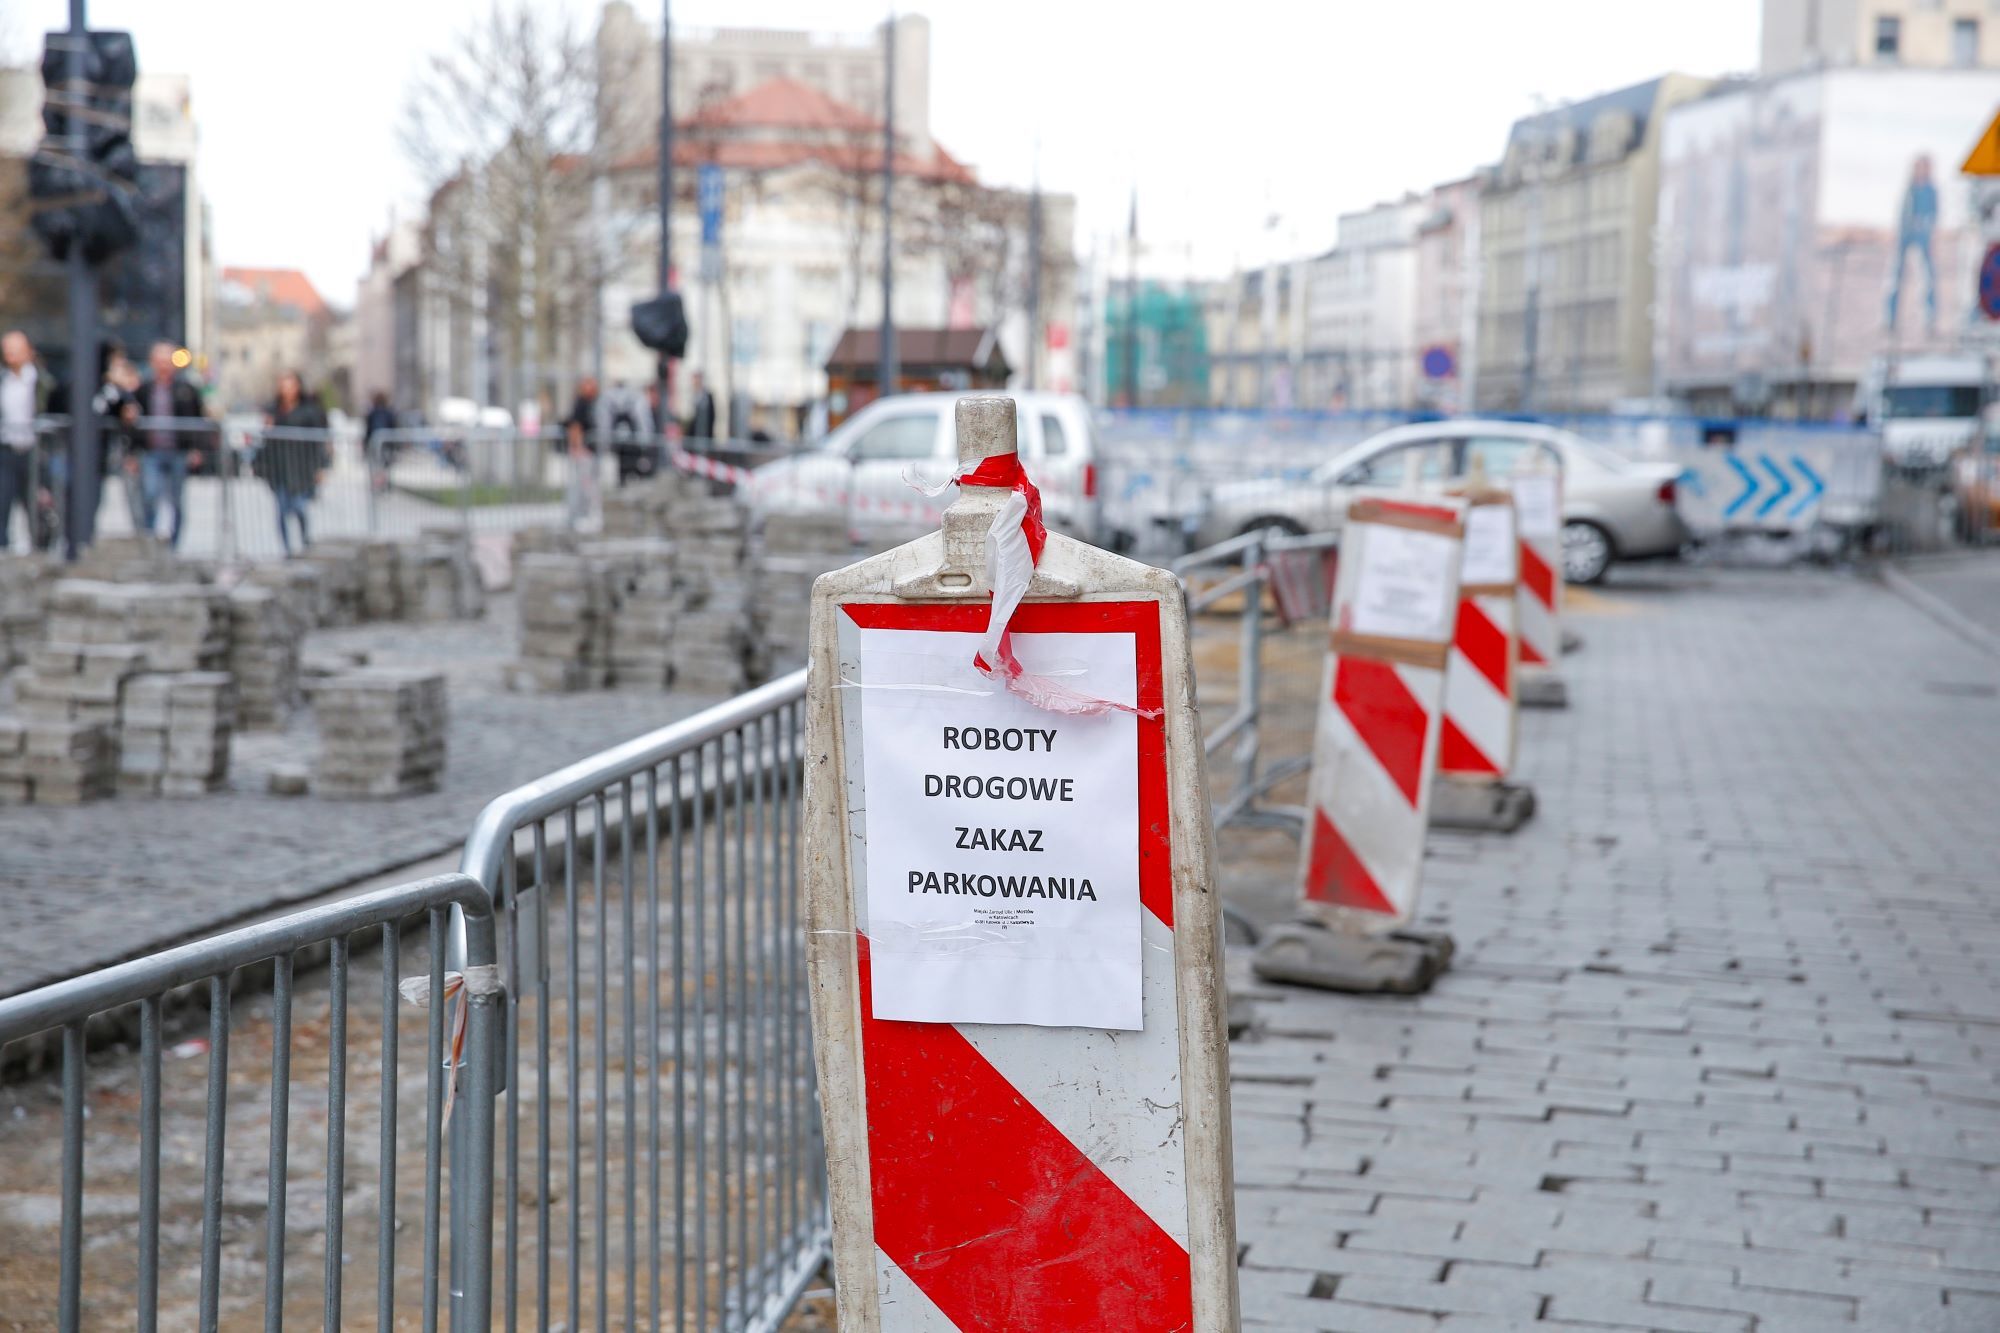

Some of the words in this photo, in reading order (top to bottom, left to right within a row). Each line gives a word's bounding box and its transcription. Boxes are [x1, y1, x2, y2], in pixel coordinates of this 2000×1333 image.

[944, 727, 1057, 752] ROBOTY
[925, 775, 1073, 801] DROGOWE
[955, 827, 1043, 851] ZAKAZ
[909, 871, 1096, 901] PARKOWANIA
